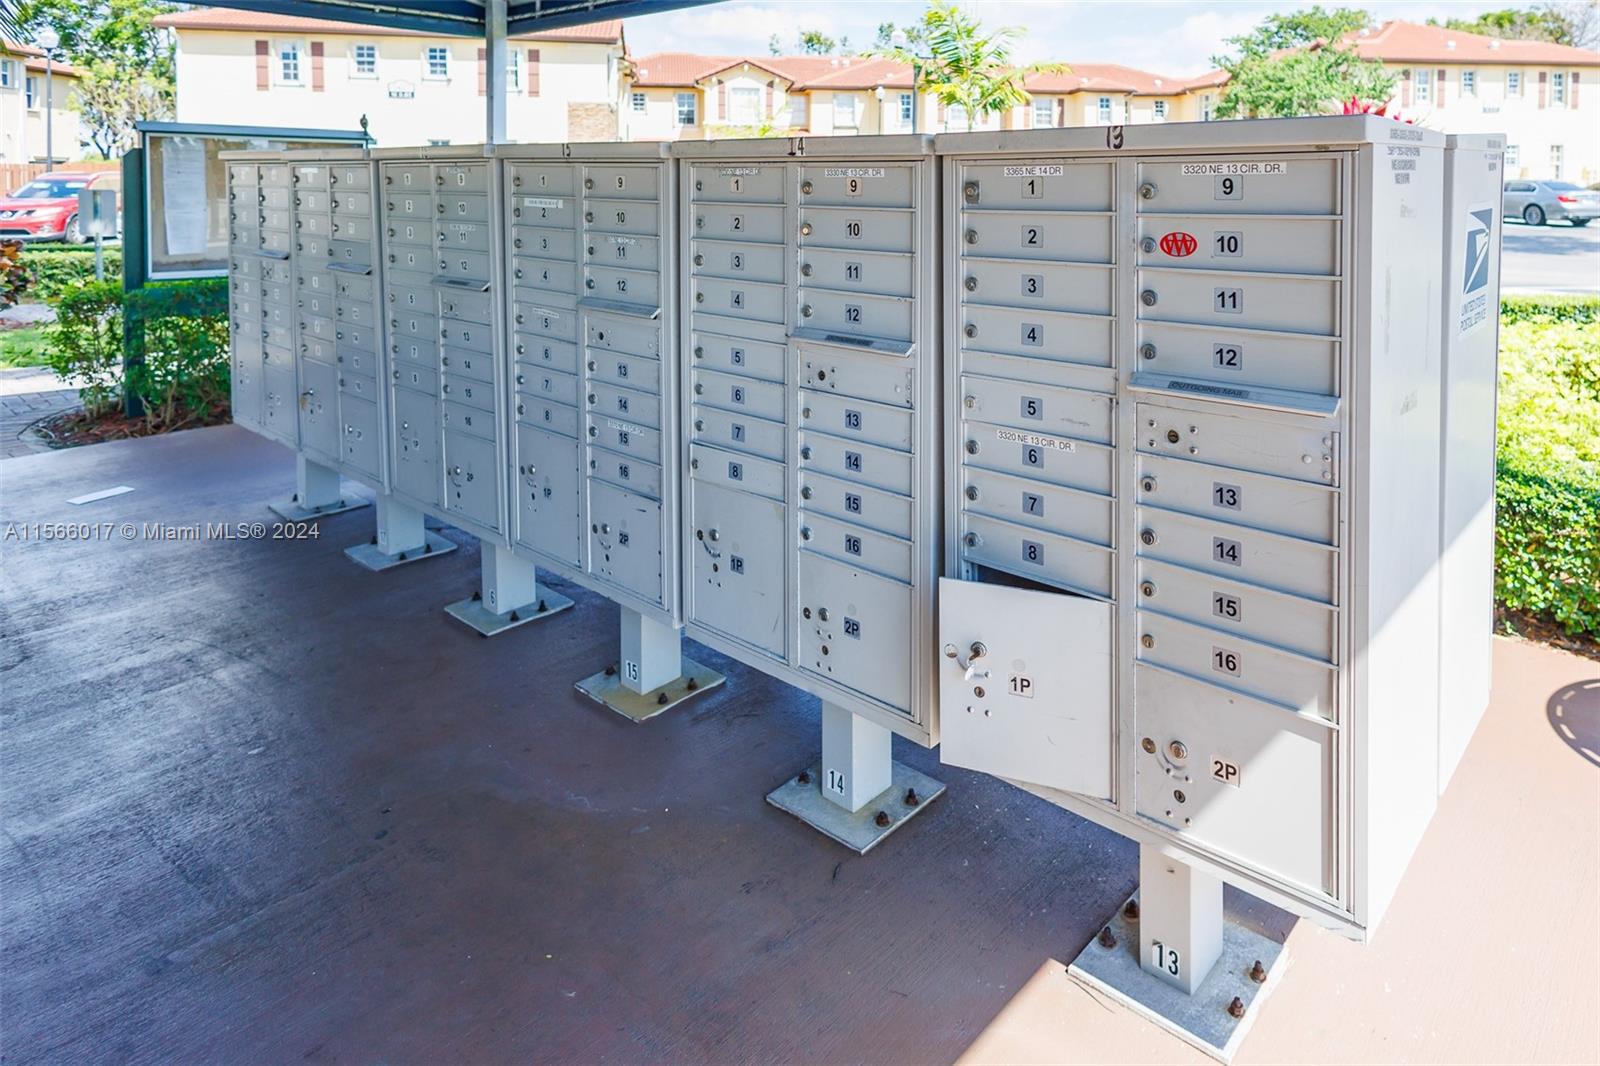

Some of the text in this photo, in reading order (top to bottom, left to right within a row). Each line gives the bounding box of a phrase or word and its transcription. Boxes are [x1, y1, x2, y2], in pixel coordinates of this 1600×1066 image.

[787, 137, 805, 156] 14
[1005, 166, 1062, 176] 3365 NE 14 DR
[1183, 165, 1207, 175] 3320
[1208, 164, 1223, 174] NE
[1226, 164, 1239, 174] 13
[1264, 163, 1284, 174] DR.
[541, 176, 546, 186] 1
[617, 177, 623, 188] 9
[734, 178, 740, 191] 1
[850, 179, 857, 192] 9
[1027, 179, 1035, 195] 1
[1222, 177, 1234, 195] 9
[541, 207, 547, 218] 2
[616, 212, 626, 223] 10
[733, 217, 740, 230] 2
[847, 222, 860, 237] 10
[542, 238, 548, 249] 3
[1027, 229, 1037, 244] 2
[617, 246, 626, 257] 11
[1216, 235, 1239, 254] 10
[734, 255, 741, 268] 3
[543, 270, 548, 281] 4
[846, 265, 859, 279] 11
[617, 280, 626, 292] 12
[1027, 277, 1037, 295] 3
[734, 293, 741, 306] 4
[1216, 290, 1237, 309] 11
[846, 307, 860, 322] 12
[544, 317, 549, 328] 5
[1026, 325, 1038, 343] 4
[544, 349, 550, 359] 6
[734, 351, 741, 363] 5
[1215, 347, 1238, 367] 12
[618, 365, 627, 377] 13
[544, 379, 550, 390] 7
[735, 388, 742, 401] 6
[618, 399, 628, 412] 14
[1027, 400, 1037, 416] 5
[545, 410, 550, 421] 8
[846, 411, 860, 427] 13
[619, 432, 628, 445] 15
[734, 426, 741, 439] 7
[998, 430, 1016, 442] 3320
[1017, 433, 1029, 444] NE
[1030, 436, 1040, 446] 13
[846, 454, 860, 469] 14
[1028, 449, 1038, 464] 6
[619, 465, 629, 477] 16
[732, 465, 739, 478] 8
[543, 487, 552, 499] 1P
[1215, 486, 1238, 507] 13
[846, 495, 860, 511] 15
[1028, 496, 1038, 512] 7
[619, 533, 629, 546] 2P
[846, 537, 860, 553] 16
[1028, 544, 1037, 561] 8
[1215, 541, 1238, 562] 14
[730, 557, 743, 571] 1P
[1215, 597, 1238, 617] 15
[844, 620, 859, 636] 2P
[1215, 650, 1238, 671] 16
[626, 662, 638, 681] 15
[1009, 676, 1032, 695] 1P
[1213, 760, 1238, 779] 2P
[828, 771, 844, 795] 14
[1157, 944, 1179, 976] 13
